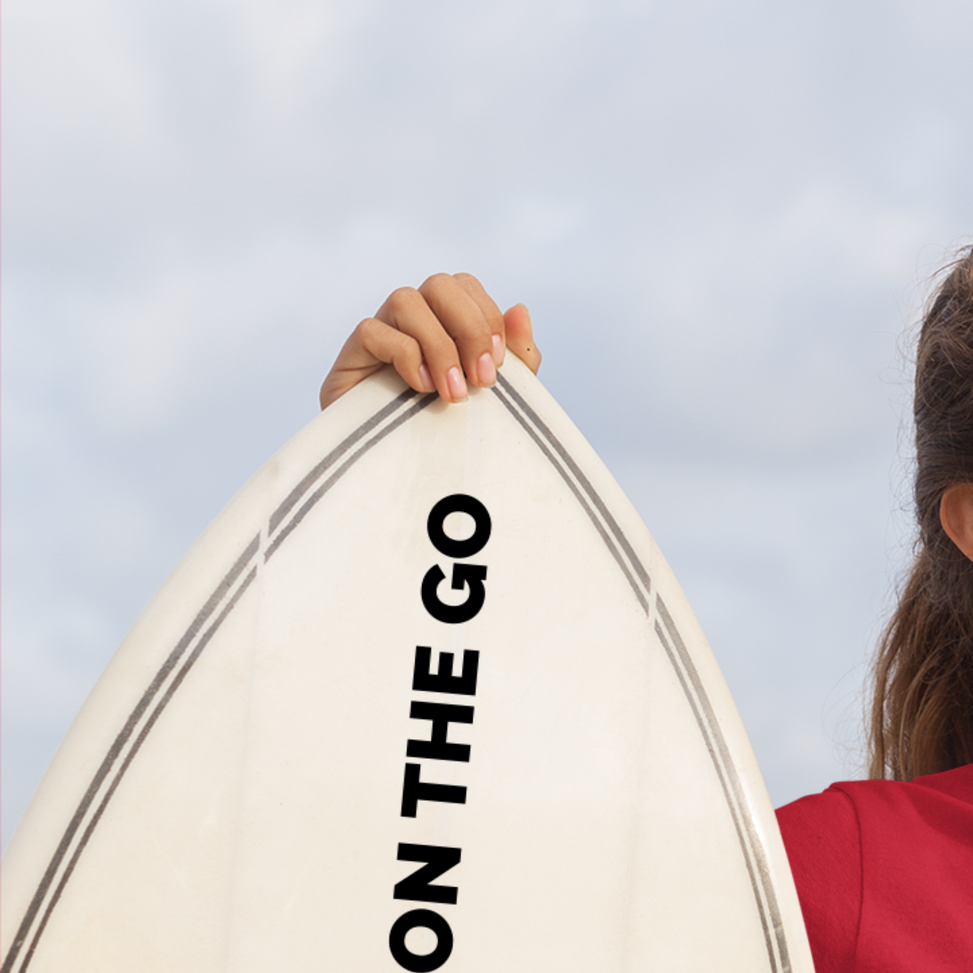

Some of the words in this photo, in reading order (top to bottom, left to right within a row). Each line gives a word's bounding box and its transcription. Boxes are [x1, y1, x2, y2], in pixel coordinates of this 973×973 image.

[420, 493, 492, 624] GO
[400, 645, 480, 819] THE
[388, 842, 462, 973] ON
